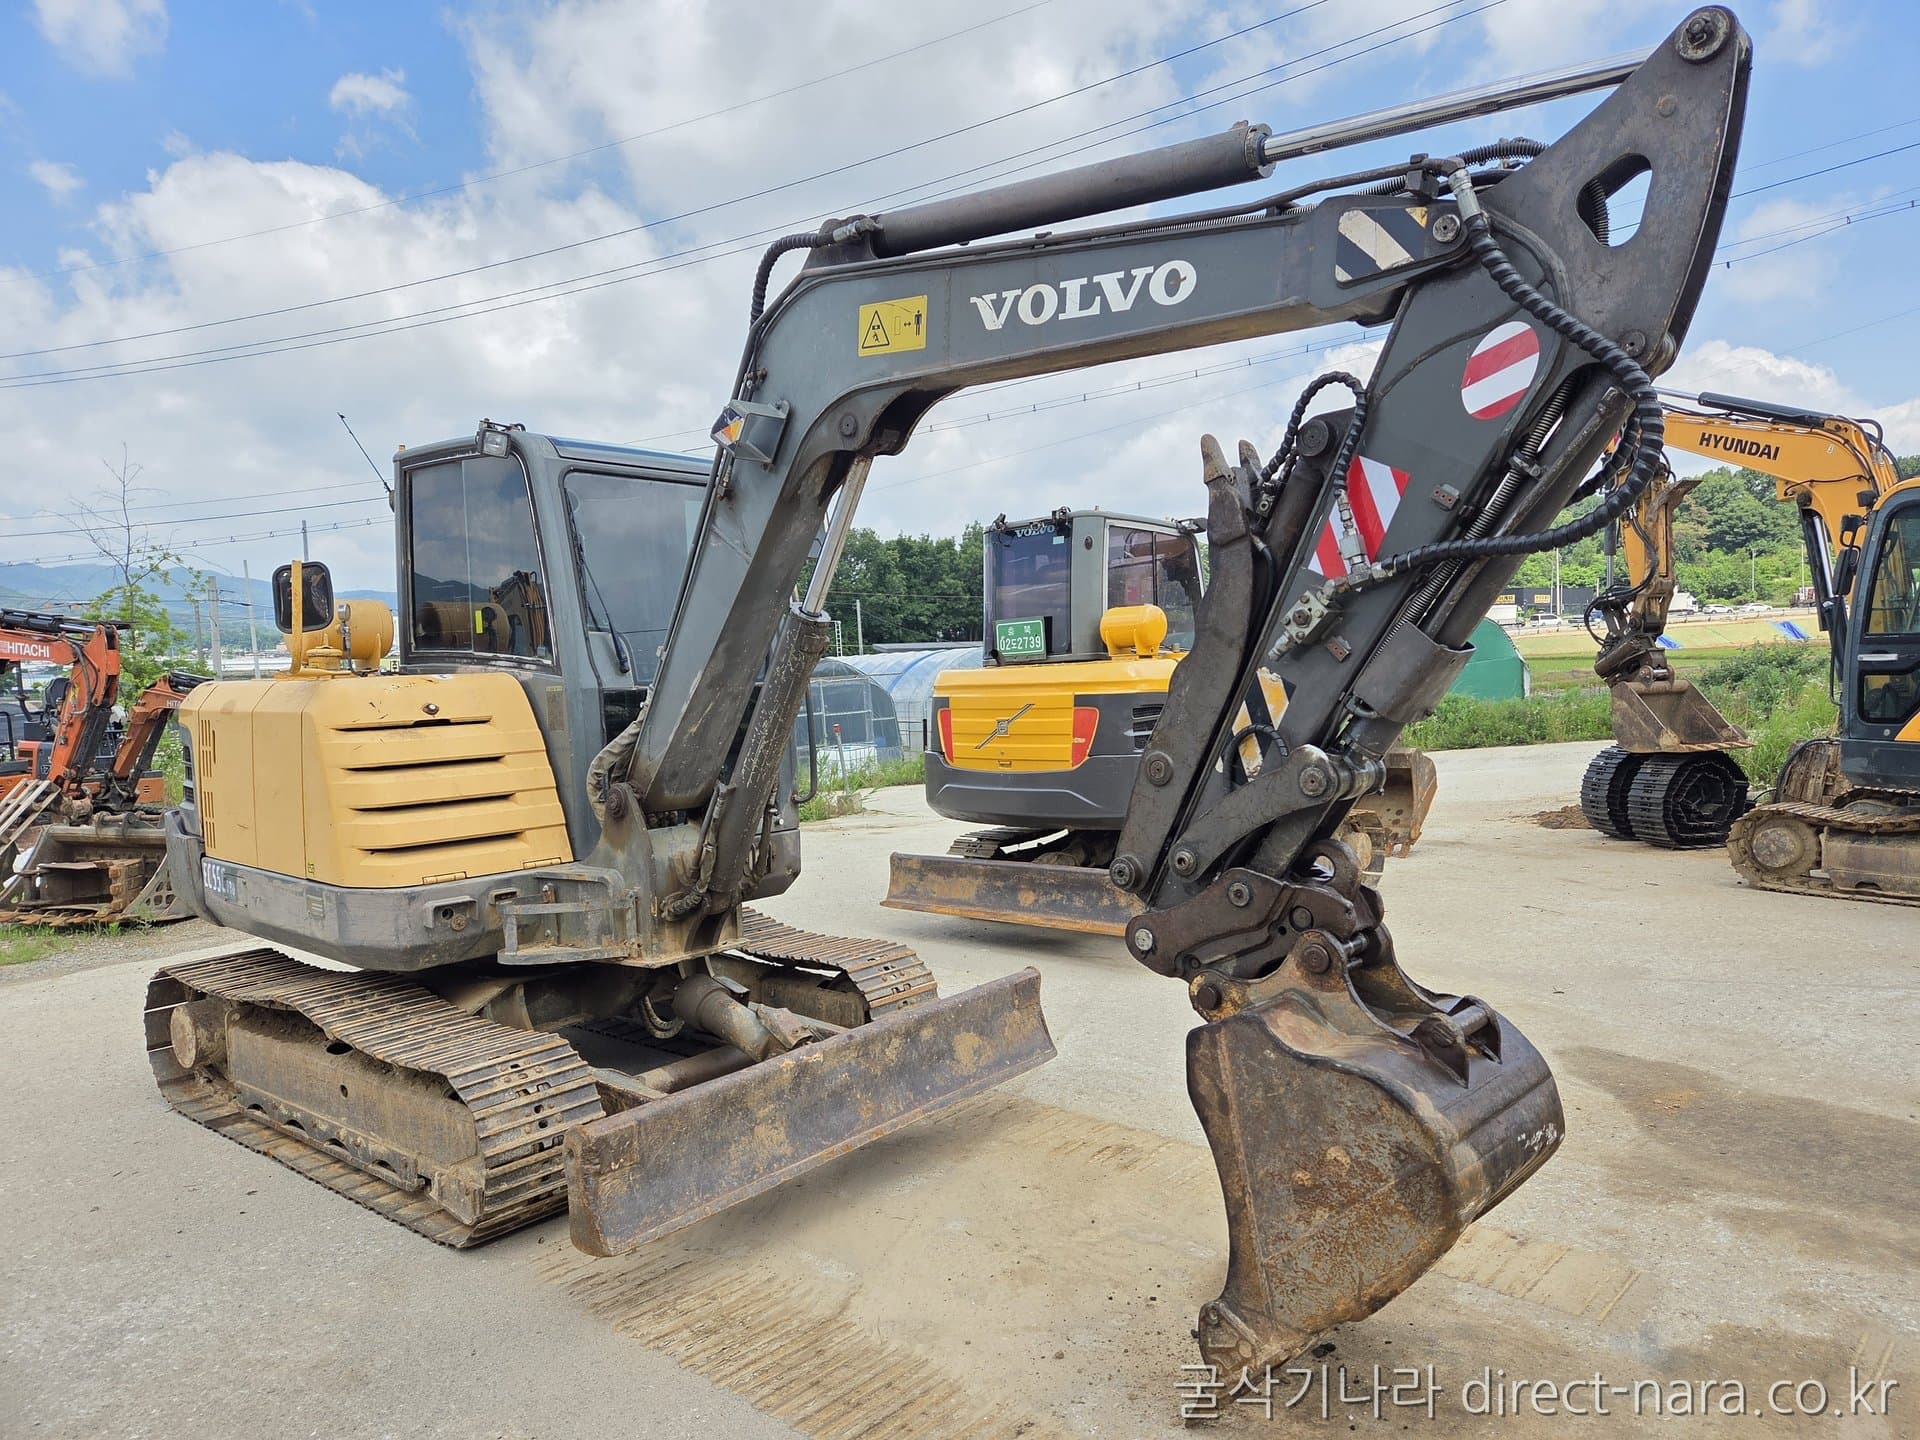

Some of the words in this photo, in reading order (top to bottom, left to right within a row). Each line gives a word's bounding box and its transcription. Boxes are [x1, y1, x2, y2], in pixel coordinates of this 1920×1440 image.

[970, 259, 1197, 331] VOLVO
[1699, 432, 1780, 461] HYUNDAI
[7, 641, 50, 658] HITACHI
